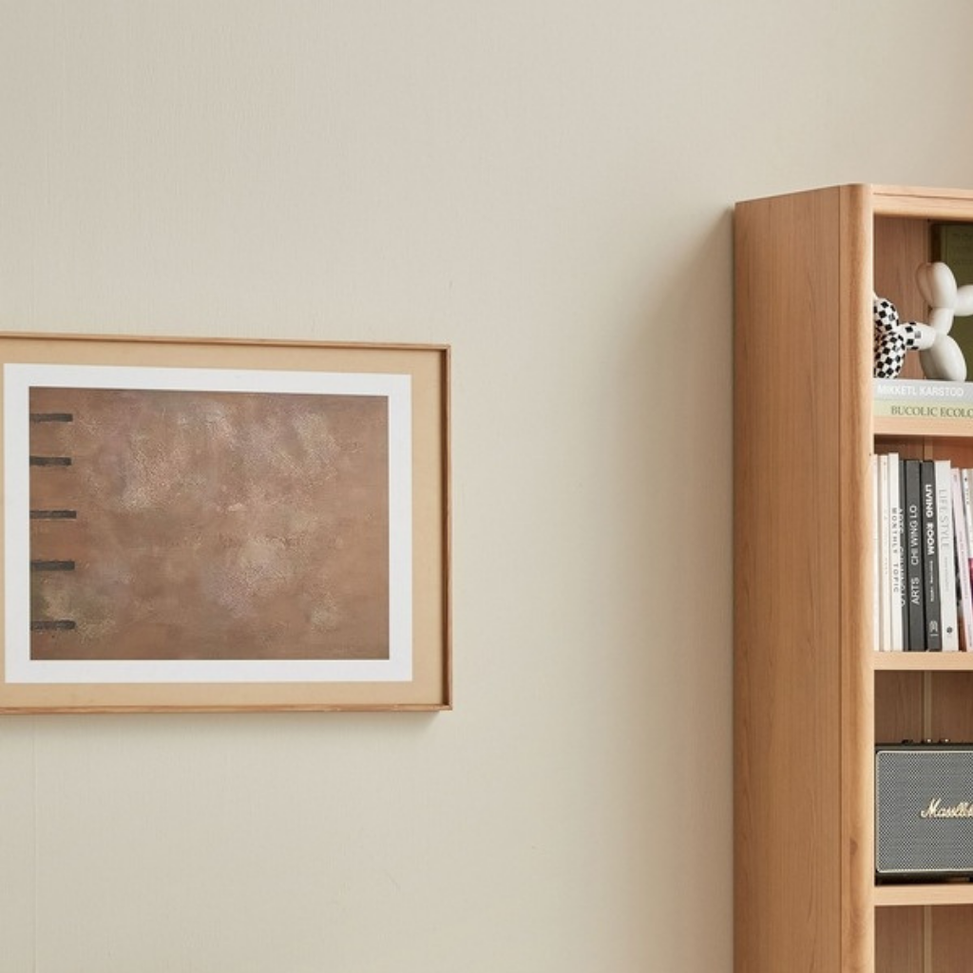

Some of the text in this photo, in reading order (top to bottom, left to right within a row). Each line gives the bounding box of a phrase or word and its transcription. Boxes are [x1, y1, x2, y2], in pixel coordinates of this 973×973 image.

[891, 405, 939, 417] BUCOLIC
[925, 484, 934, 518] LIVING
[910, 504, 920, 605] ARTS CHI WING LO
[926, 522, 935, 556] ROOM
